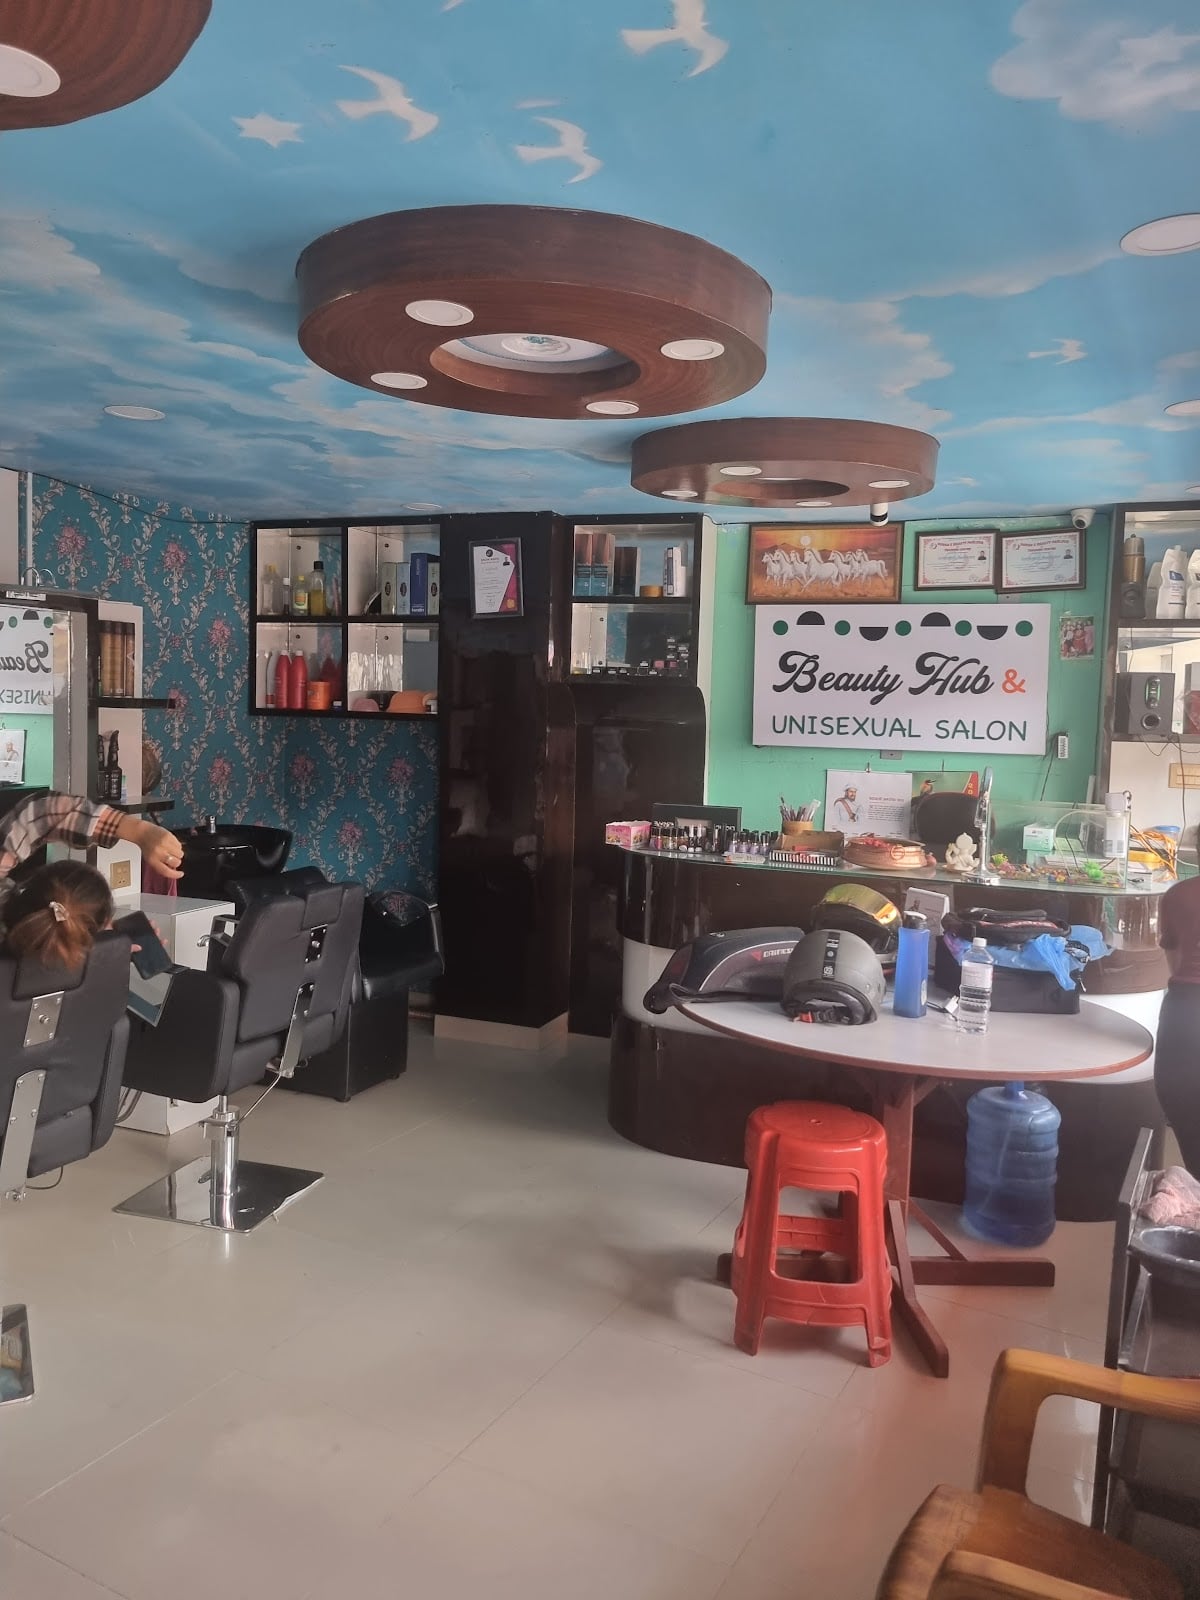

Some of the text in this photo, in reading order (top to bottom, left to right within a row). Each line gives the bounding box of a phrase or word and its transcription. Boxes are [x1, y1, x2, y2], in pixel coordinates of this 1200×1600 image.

[772, 651, 1026, 706] Beauty Hub &
[772, 715, 1027, 742] UNISEXUAL SALON
